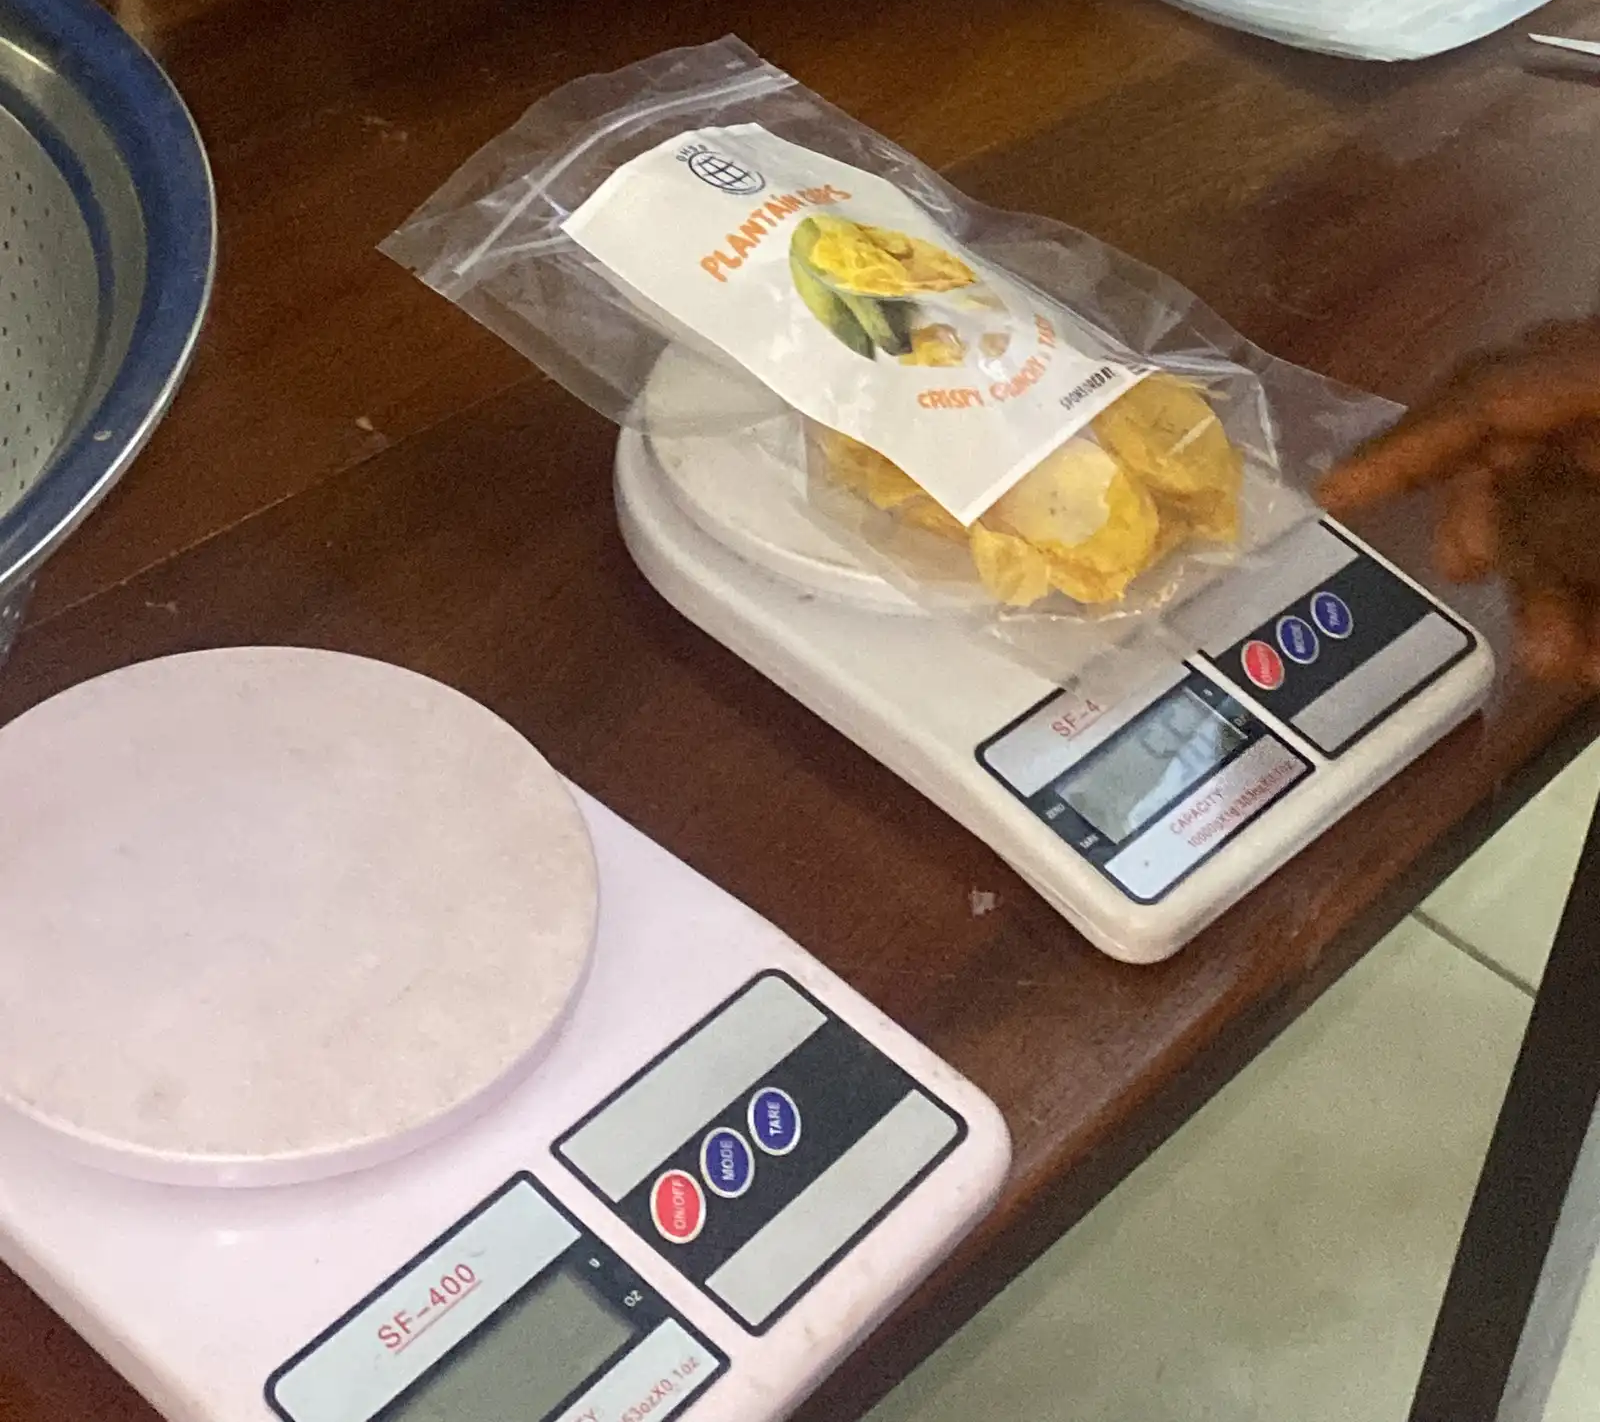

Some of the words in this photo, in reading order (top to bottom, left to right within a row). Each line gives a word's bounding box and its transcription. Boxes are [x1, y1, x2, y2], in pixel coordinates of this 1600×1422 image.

[1051, 698, 1101, 738] SF-4
[766, 1100, 785, 1137] TARE
[719, 1139, 735, 1181] MODE
[671, 1179, 687, 1231] ON/OFF
[377, 1263, 476, 1349] SF-400
